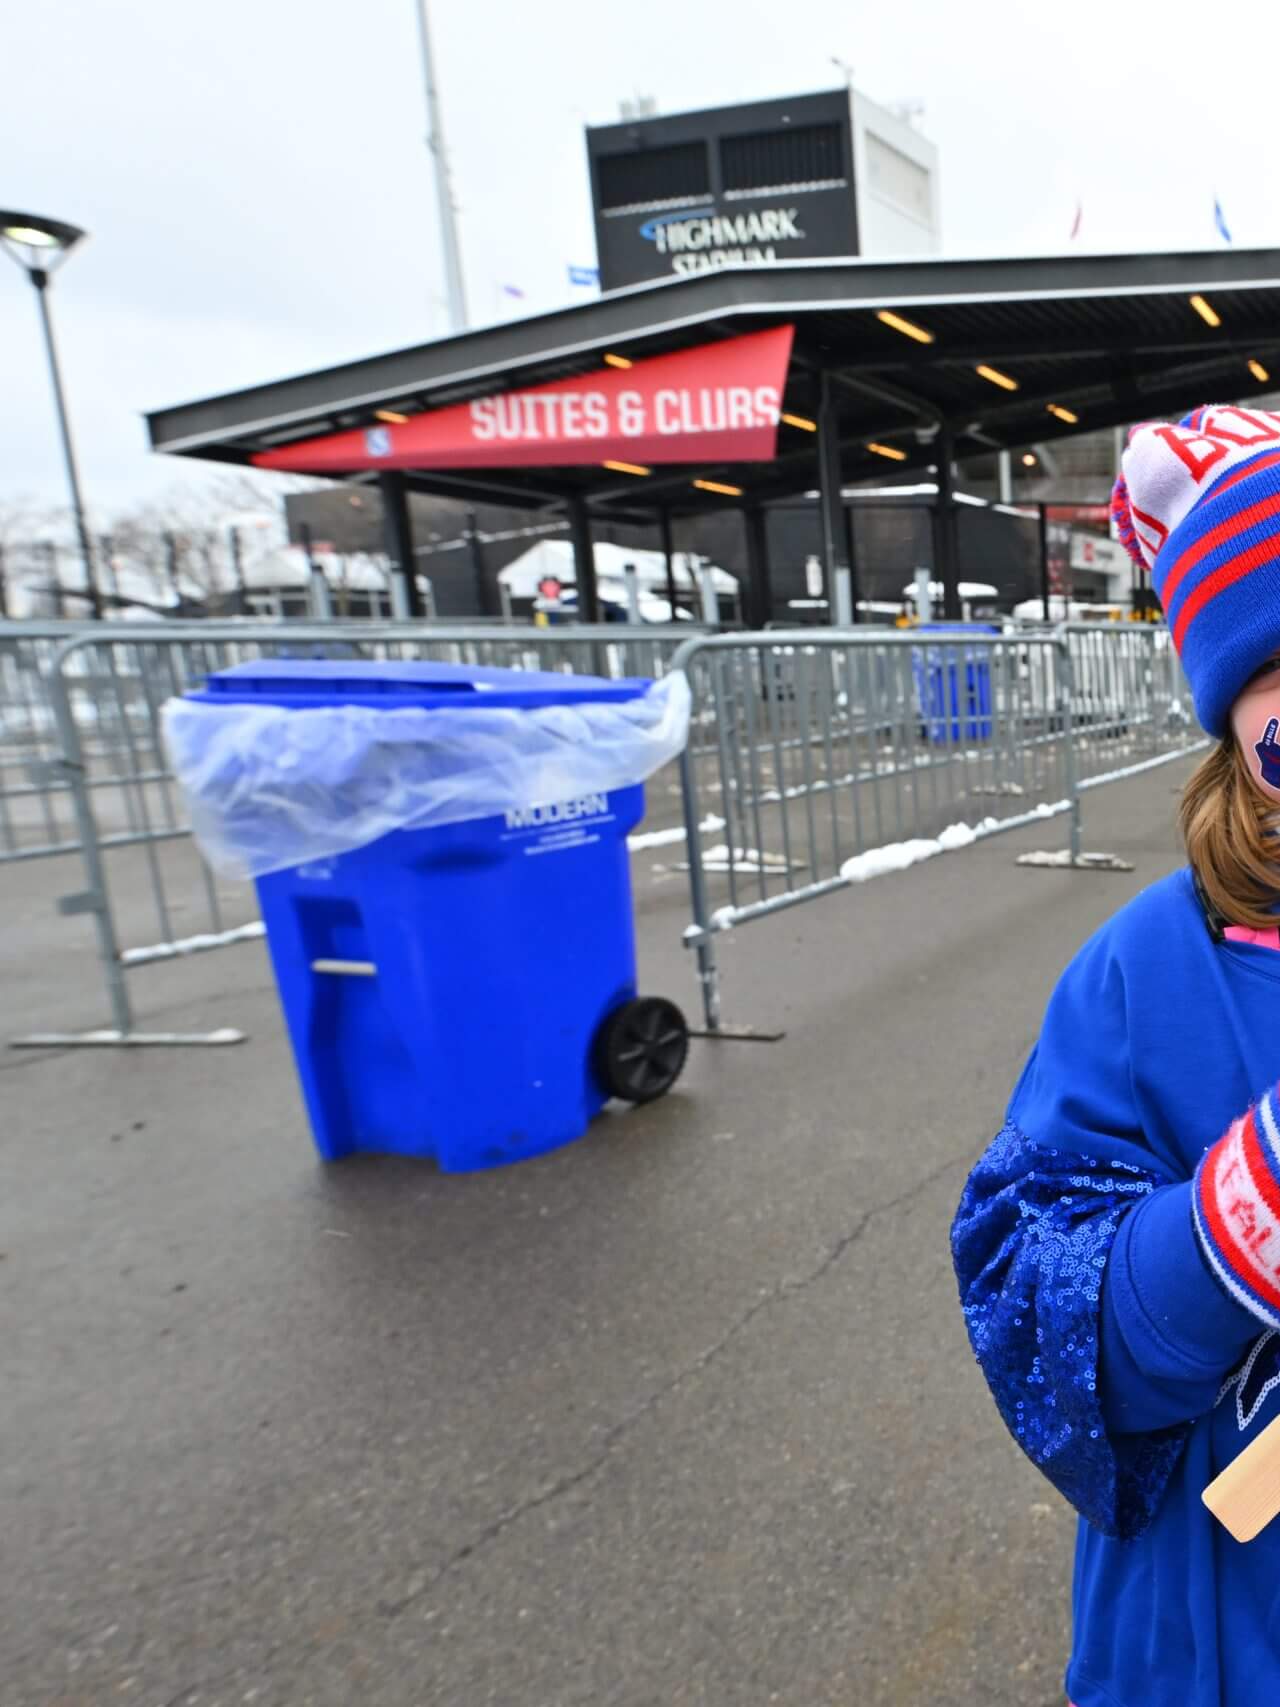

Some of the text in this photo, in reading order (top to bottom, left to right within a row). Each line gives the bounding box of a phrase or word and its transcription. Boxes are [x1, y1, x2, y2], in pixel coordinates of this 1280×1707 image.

[656, 208, 799, 252] HIGHMARK
[470, 391, 608, 440] SUITES
[619, 391, 646, 437] &
[505, 791, 608, 830] MODERN
